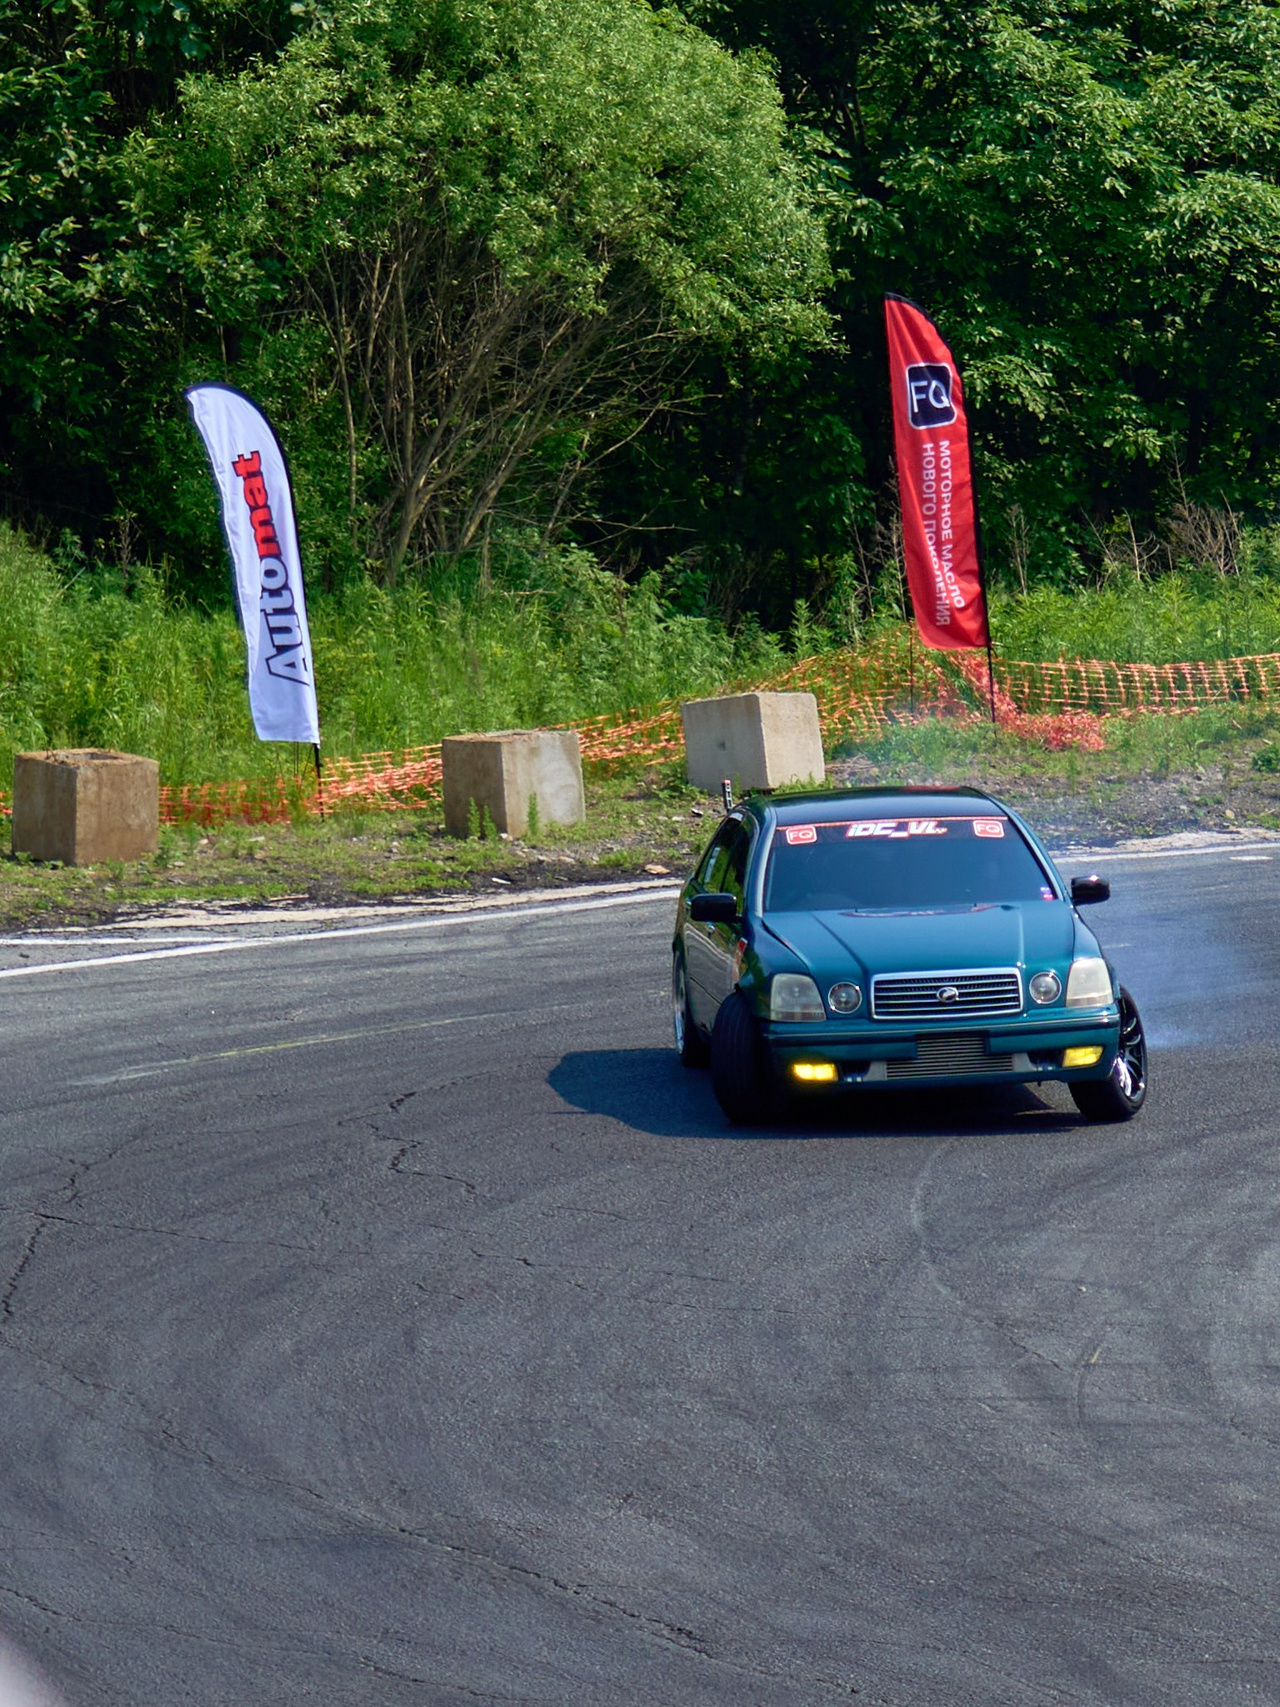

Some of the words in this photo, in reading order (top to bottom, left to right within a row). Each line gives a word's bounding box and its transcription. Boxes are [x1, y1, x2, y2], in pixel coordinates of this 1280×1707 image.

[909, 379, 951, 412] FQ
[922, 442, 937, 516] НОВОГО
[938, 440, 953, 545] МОТОРНОЕ
[232, 450, 310, 686] Automet
[923, 519, 951, 626] ПОКОЛЕНИЯ
[940, 547, 965, 609] МАСЛО
